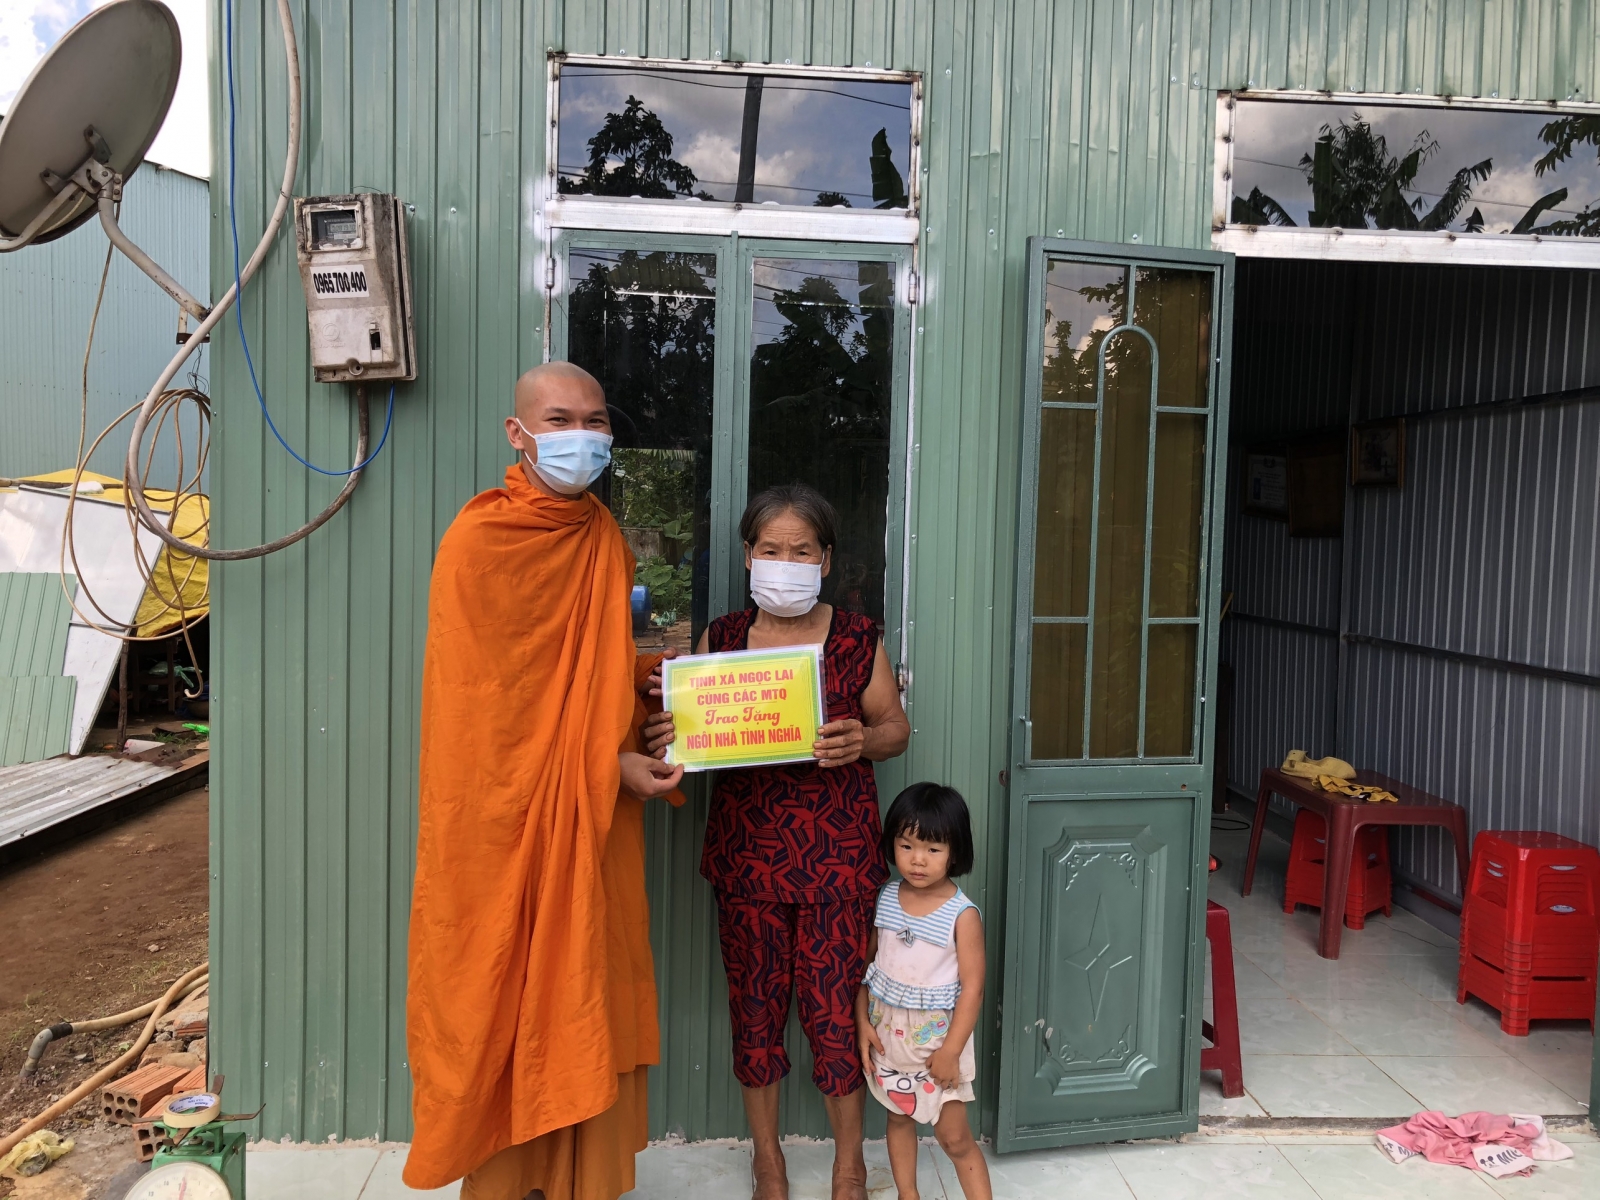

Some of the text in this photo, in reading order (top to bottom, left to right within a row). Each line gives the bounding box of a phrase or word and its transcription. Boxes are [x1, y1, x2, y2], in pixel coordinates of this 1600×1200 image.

[689, 669, 794, 690] TỊNH XÁ NGỌC LAI
[697, 688, 787, 706] CÙNG CÁC MTQ
[704, 706, 781, 726] Trao Tặng
[686, 724, 802, 750] NGÔI NHÀ TÌNH NGHĨA
